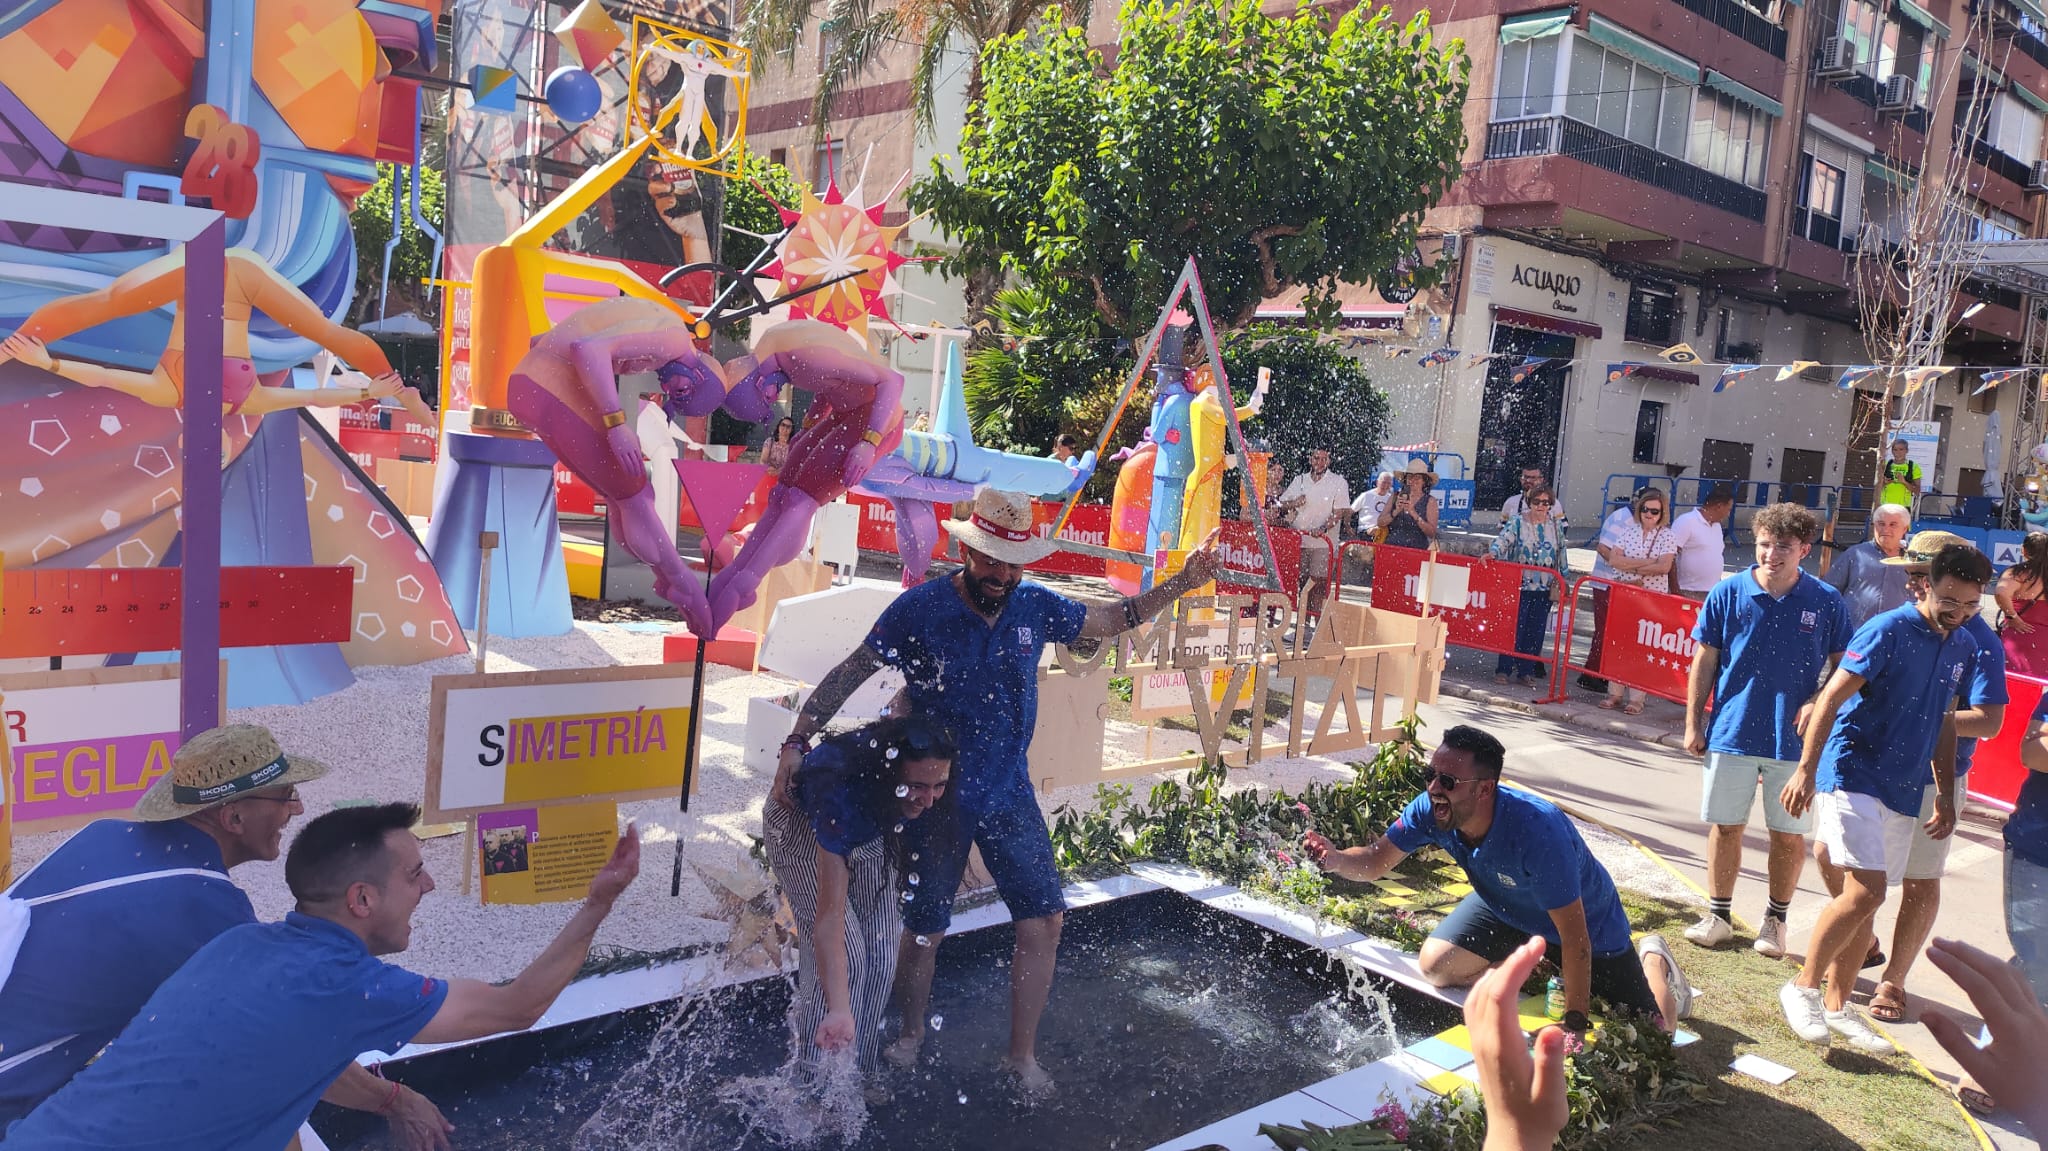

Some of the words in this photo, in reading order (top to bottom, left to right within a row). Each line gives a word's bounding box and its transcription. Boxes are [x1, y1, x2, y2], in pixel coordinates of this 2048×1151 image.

[180, 103, 259, 219] 28
[1511, 264, 1581, 297] ACUARIO
[62, 605, 74, 614] 24
[96, 604, 108, 613] 25
[159, 602, 170, 611] 27
[1149, 673, 1170, 689] CON
[1182, 650, 1407, 768] VITAL
[478, 705, 668, 767] SIMETRÍA
[11, 740, 174, 805] EGLA
